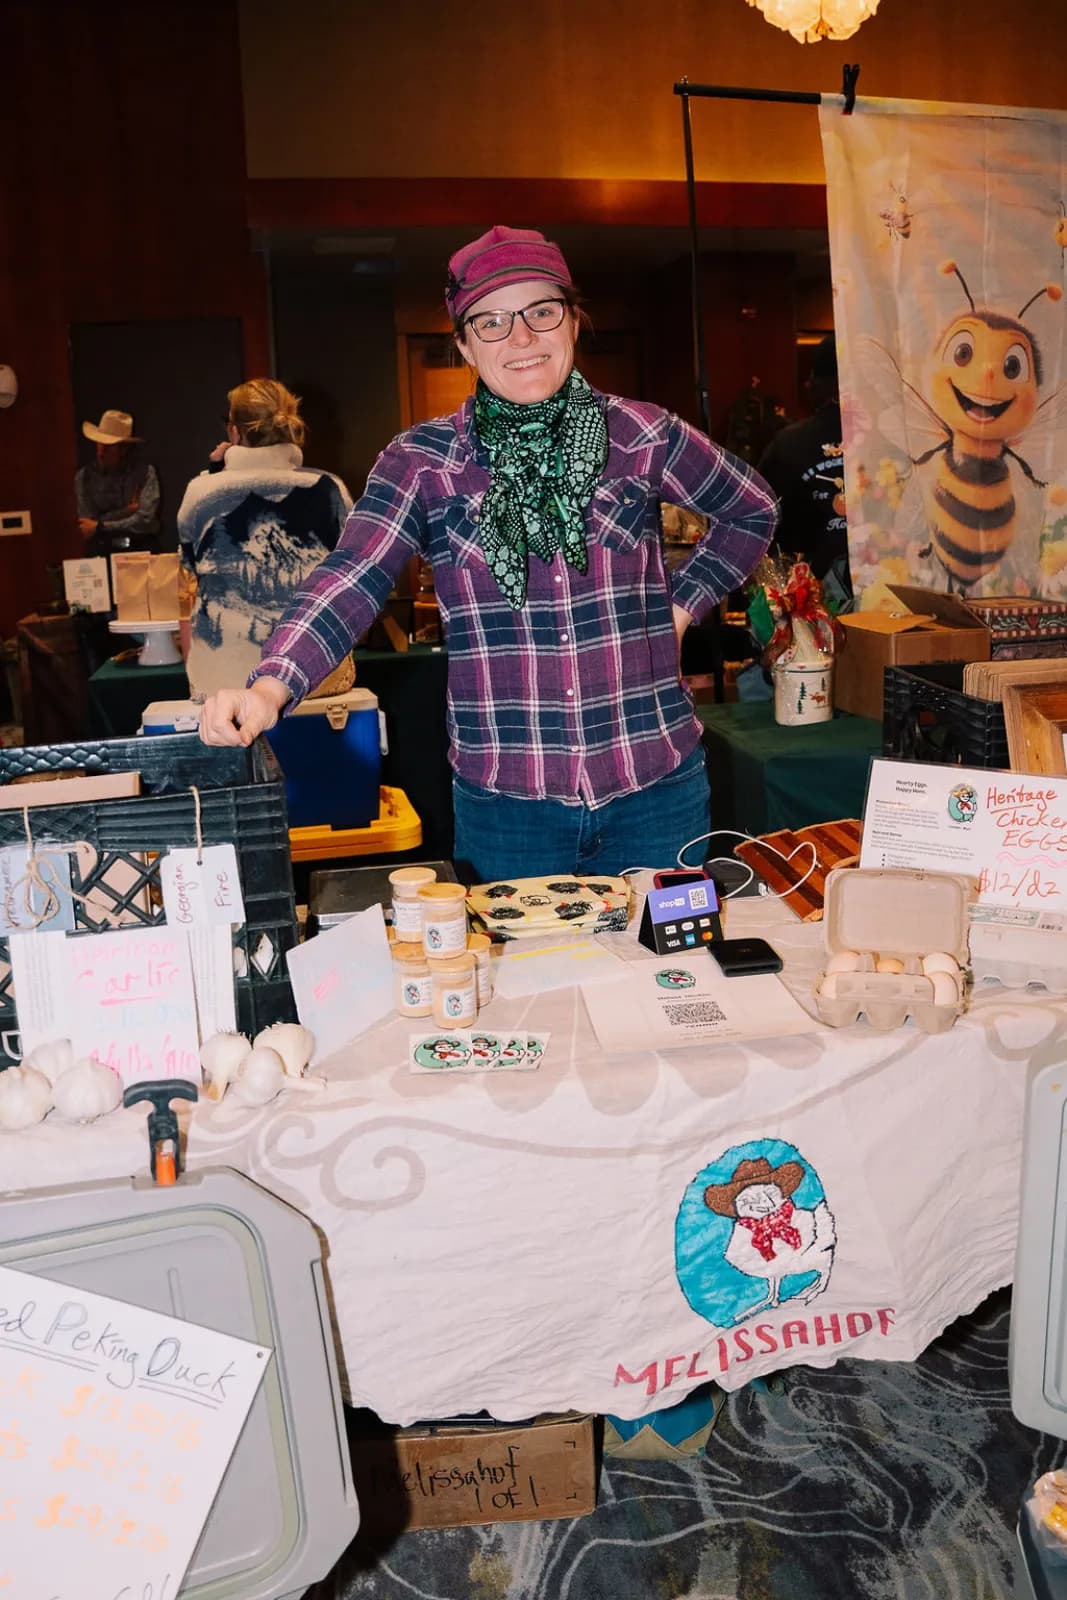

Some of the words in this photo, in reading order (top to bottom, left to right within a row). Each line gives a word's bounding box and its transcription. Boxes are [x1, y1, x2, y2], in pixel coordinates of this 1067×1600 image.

[986, 784, 1058, 811] Heritage
[1002, 829, 1067, 851] EGGS
[172, 863, 199, 924] Georgian
[213, 871, 232, 907] Fire
[666, 939, 681, 948] VISA
[44, 1301, 139, 1389] Peking
[146, 1336, 235, 1398] Duck
[374, 1445, 520, 1498] elissahof
